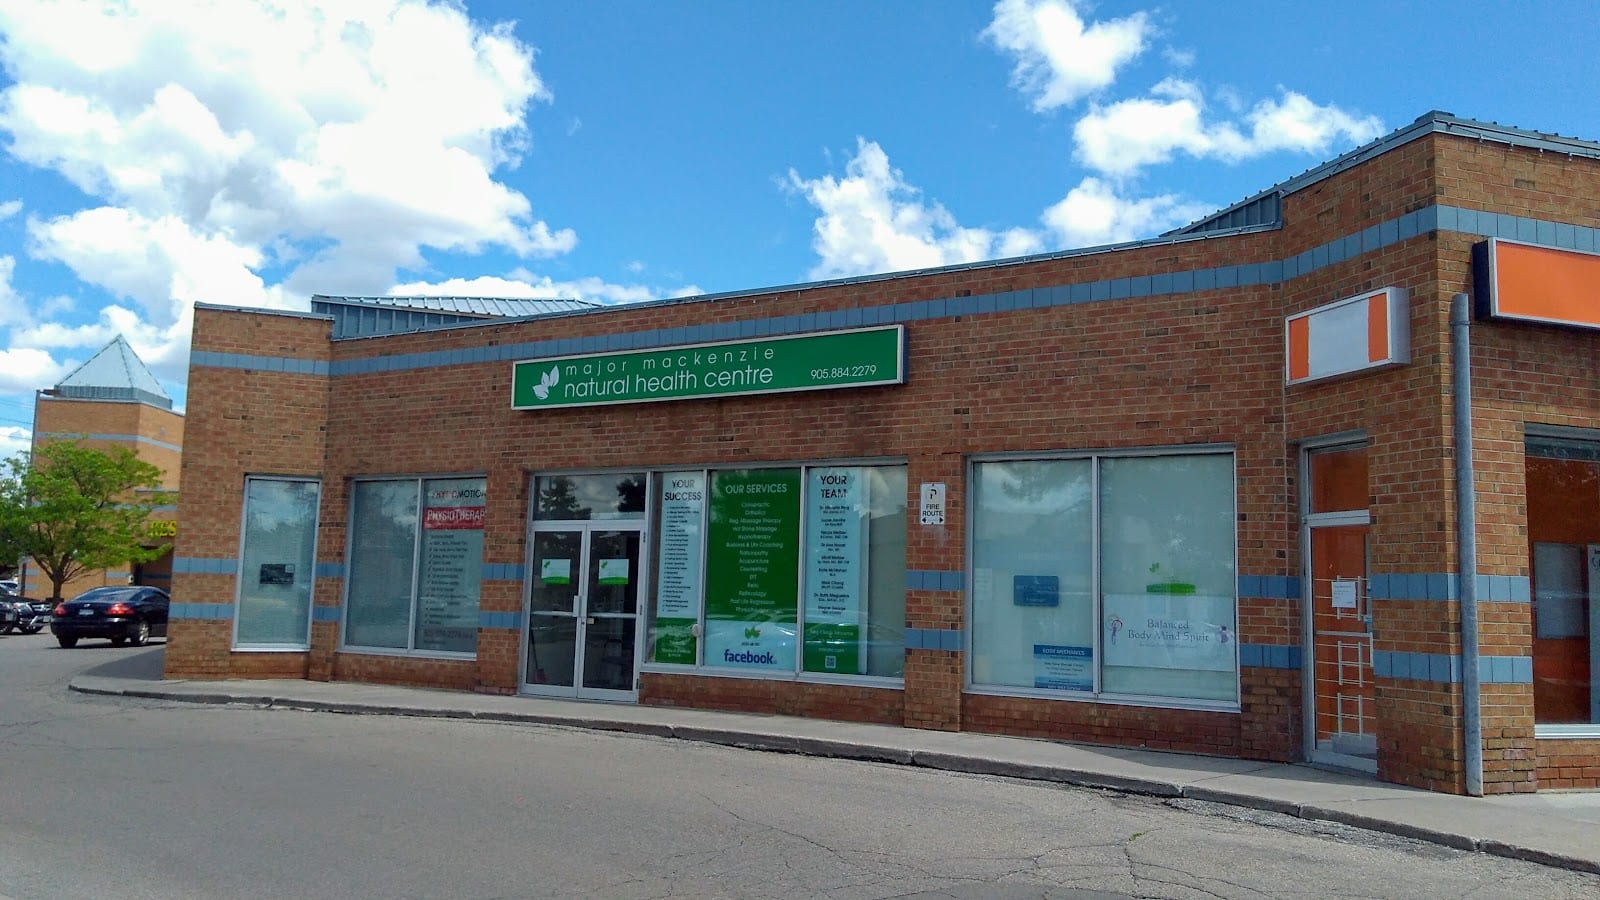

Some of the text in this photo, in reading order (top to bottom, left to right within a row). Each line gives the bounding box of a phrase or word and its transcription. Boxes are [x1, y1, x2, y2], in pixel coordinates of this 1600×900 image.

[565, 347, 774, 377] major mackenzie
[810, 364, 877, 380] 905.884.2279
[564, 364, 774, 398] natural health centre
[671, 479, 696, 488] YOUR
[820, 475, 847, 485] YOUR
[725, 483, 788, 494] OUR SERVICES
[820, 488, 847, 499] TEAM
[664, 491, 702, 501] SUCCESS
[427, 508, 485, 521] PHYSIOTHERAP
[1147, 618, 1190, 629] Balanced
[1128, 629, 1209, 642] Body Mind Spirit
[724, 648, 774, 665] facebook
